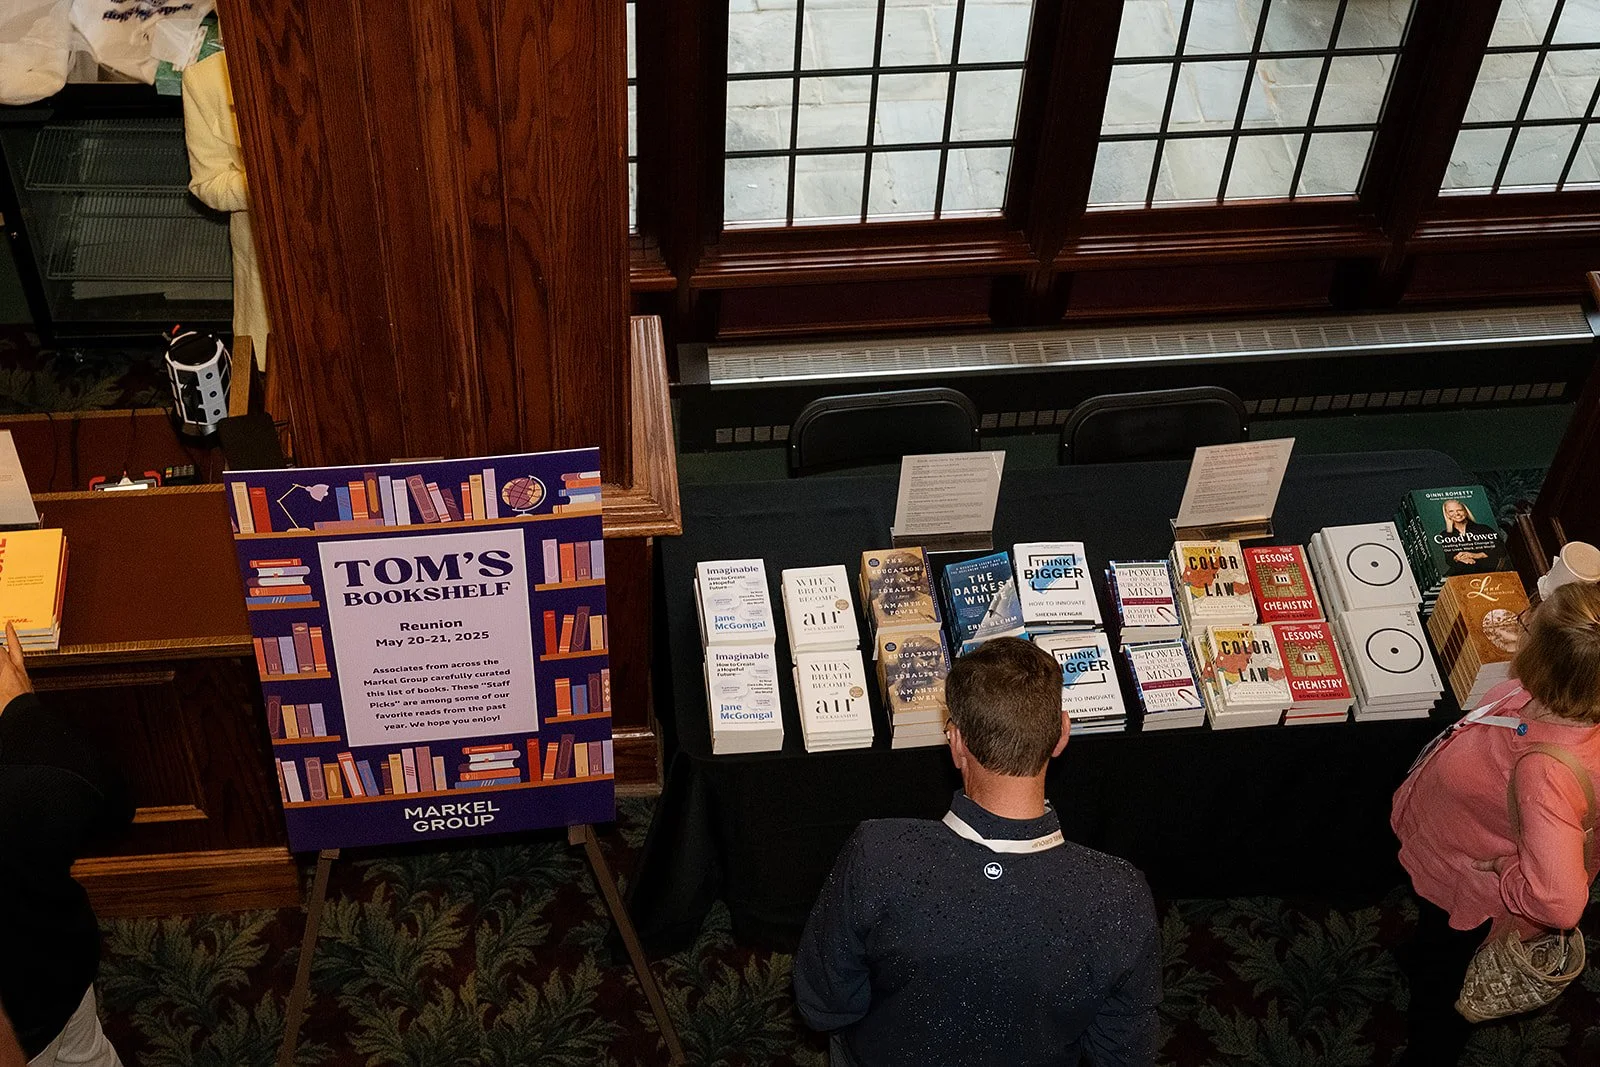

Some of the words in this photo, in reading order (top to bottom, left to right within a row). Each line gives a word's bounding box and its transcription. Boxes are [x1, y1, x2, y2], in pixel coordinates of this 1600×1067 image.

[1434, 533, 1465, 544] Good
[1466, 532, 1498, 541] Power
[1189, 556, 1238, 570] COLOR
[1254, 553, 1294, 563] LESSONS
[334, 550, 514, 588] TOM'S
[707, 566, 758, 575] Imaginable
[872, 566, 920, 574] EDUCATION
[1024, 568, 1084, 579] BIGGER
[796, 577, 835, 586] WHEN
[968, 572, 993, 584] THE
[343, 581, 510, 606] BOOKSHELF
[798, 586, 836, 594] BREATH
[1128, 588, 1163, 596] MIND
[1204, 582, 1235, 596] LAW
[964, 592, 1007, 605] WHITE
[878, 601, 927, 609] SAMANTHA
[1263, 600, 1312, 611] CHEMISTRY
[803, 611, 841, 625] air
[400, 619, 462, 632] Reunion
[715, 620, 766, 630] McGonigal
[376, 638, 403, 648] May
[408, 635, 451, 645] 20-21,
[455, 631, 489, 641] 2025
[1282, 631, 1324, 640] LESSONS
[1144, 648, 1184, 659] POWER
[1221, 640, 1272, 655] COLOR
[716, 652, 769, 661] Imaginable
[888, 651, 938, 659] EDUCATION
[1058, 650, 1095, 660] THINK
[372, 664, 424, 674] Associates
[426, 662, 448, 671] from
[810, 663, 850, 671] WHEN
[1060, 660, 1110, 674] IGGER
[400, 676, 428, 685] Group
[430, 672, 473, 683] carefully
[474, 669, 511, 678] curated
[895, 671, 939, 680] IDEALIST
[1146, 668, 1182, 680] MIND
[1238, 668, 1269, 682] LAW
[366, 689, 385, 698] this
[417, 685, 449, 694] books.
[451, 682, 479, 690] These
[1292, 679, 1343, 689] CHEMISTRY
[895, 687, 945, 696] SAMANTHA
[720, 704, 742, 712] Jane
[816, 698, 854, 713] air
[375, 711, 413, 720] favorite
[415, 708, 442, 716] reads
[486, 704, 506, 712] past
[720, 711, 773, 720] McGonigal
[384, 723, 408, 731] year.
[427, 718, 451, 727] hope
[472, 715, 501, 724] enjoy!
[404, 801, 500, 819] MARKEL
[413, 815, 494, 832] GROUP
